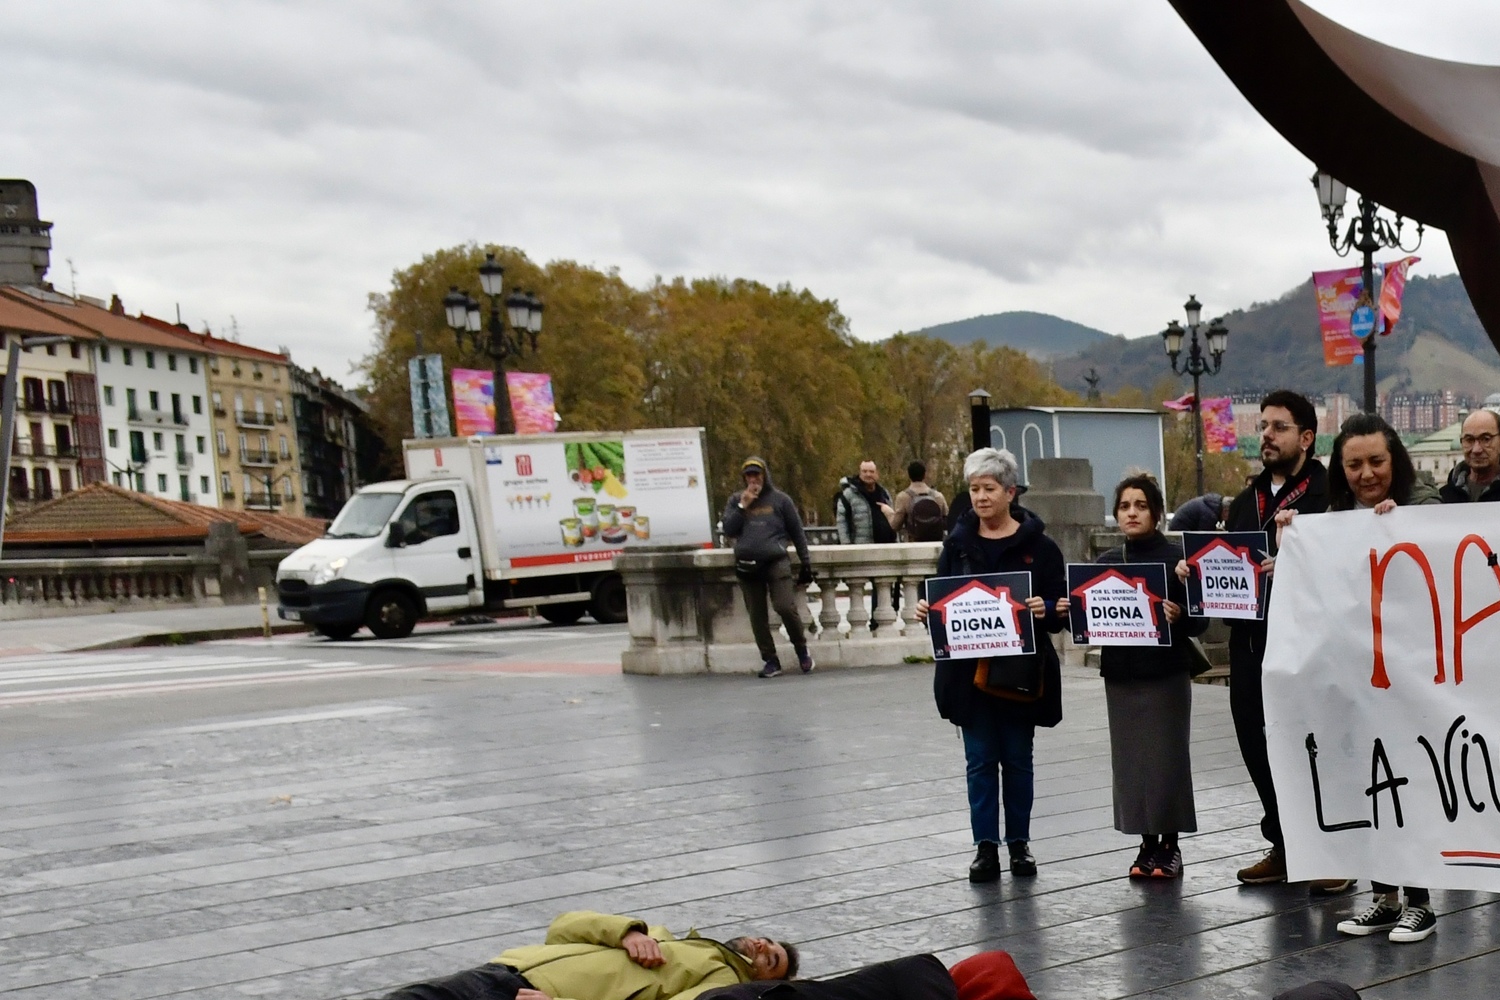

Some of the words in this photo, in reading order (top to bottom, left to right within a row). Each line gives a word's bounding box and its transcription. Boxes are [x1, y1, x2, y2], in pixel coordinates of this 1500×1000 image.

[1205, 576, 1249, 591] DIGNA
[1091, 606, 1143, 619] DIGNA
[951, 616, 1006, 632] DIGNA
[1305, 731, 1409, 833] LA
